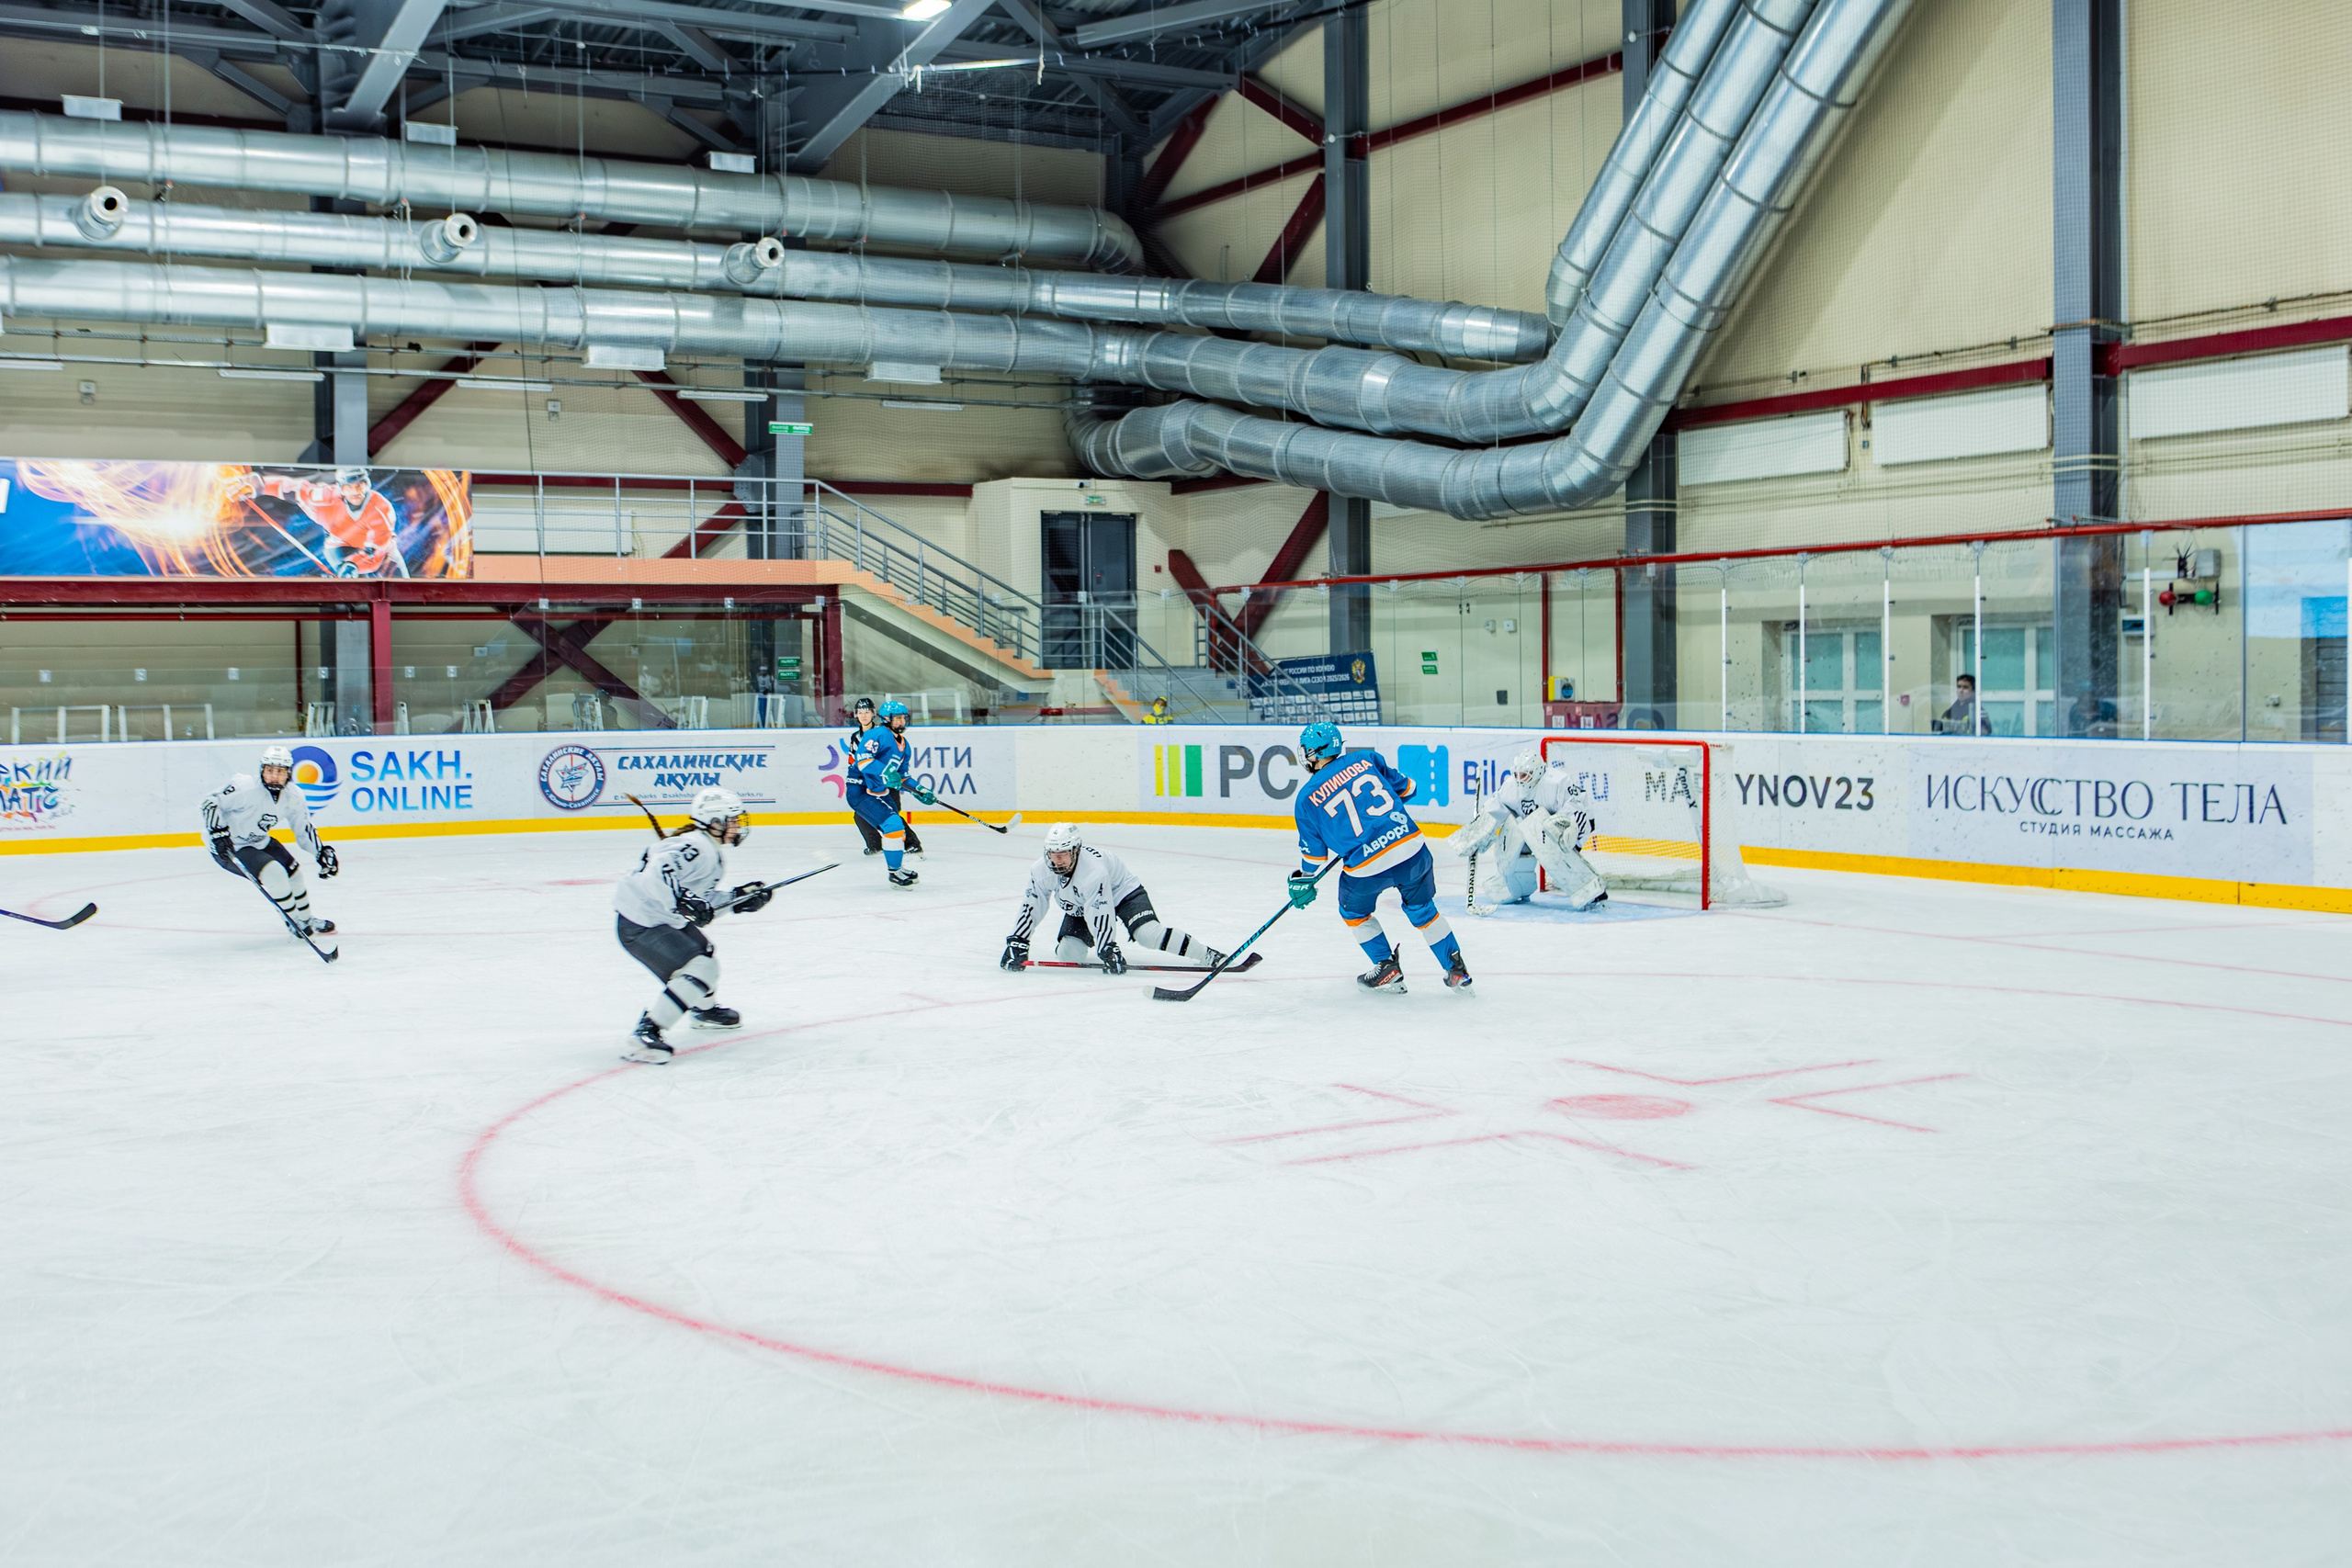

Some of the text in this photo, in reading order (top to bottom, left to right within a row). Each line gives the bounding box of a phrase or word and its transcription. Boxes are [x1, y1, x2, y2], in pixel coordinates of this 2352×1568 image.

[1316, 664, 1335, 672] ХОКЕЮ
[865, 739, 879, 754] 43
[913, 746, 972, 769] ИТИ
[351, 750, 472, 782] SAKH.
[617, 754, 768, 773] САХАЛИНСКИЕ
[653, 773, 721, 791] АКУЛЫ
[910, 773, 977, 795] ОЛЛ
[1308, 759, 1374, 807] КУЛИШОВА
[351, 785, 473, 812] ONLINE
[1323, 773, 1395, 838] 73
[1927, 774, 2288, 825] ИСКУССТВО ТЕЛА
[1363, 823, 1409, 857] Аврора
[2019, 820, 2175, 840] СТУДИЯ МАССАЖА
[681, 843, 699, 862] 13
[1466, 853, 1476, 908] HERWOO
